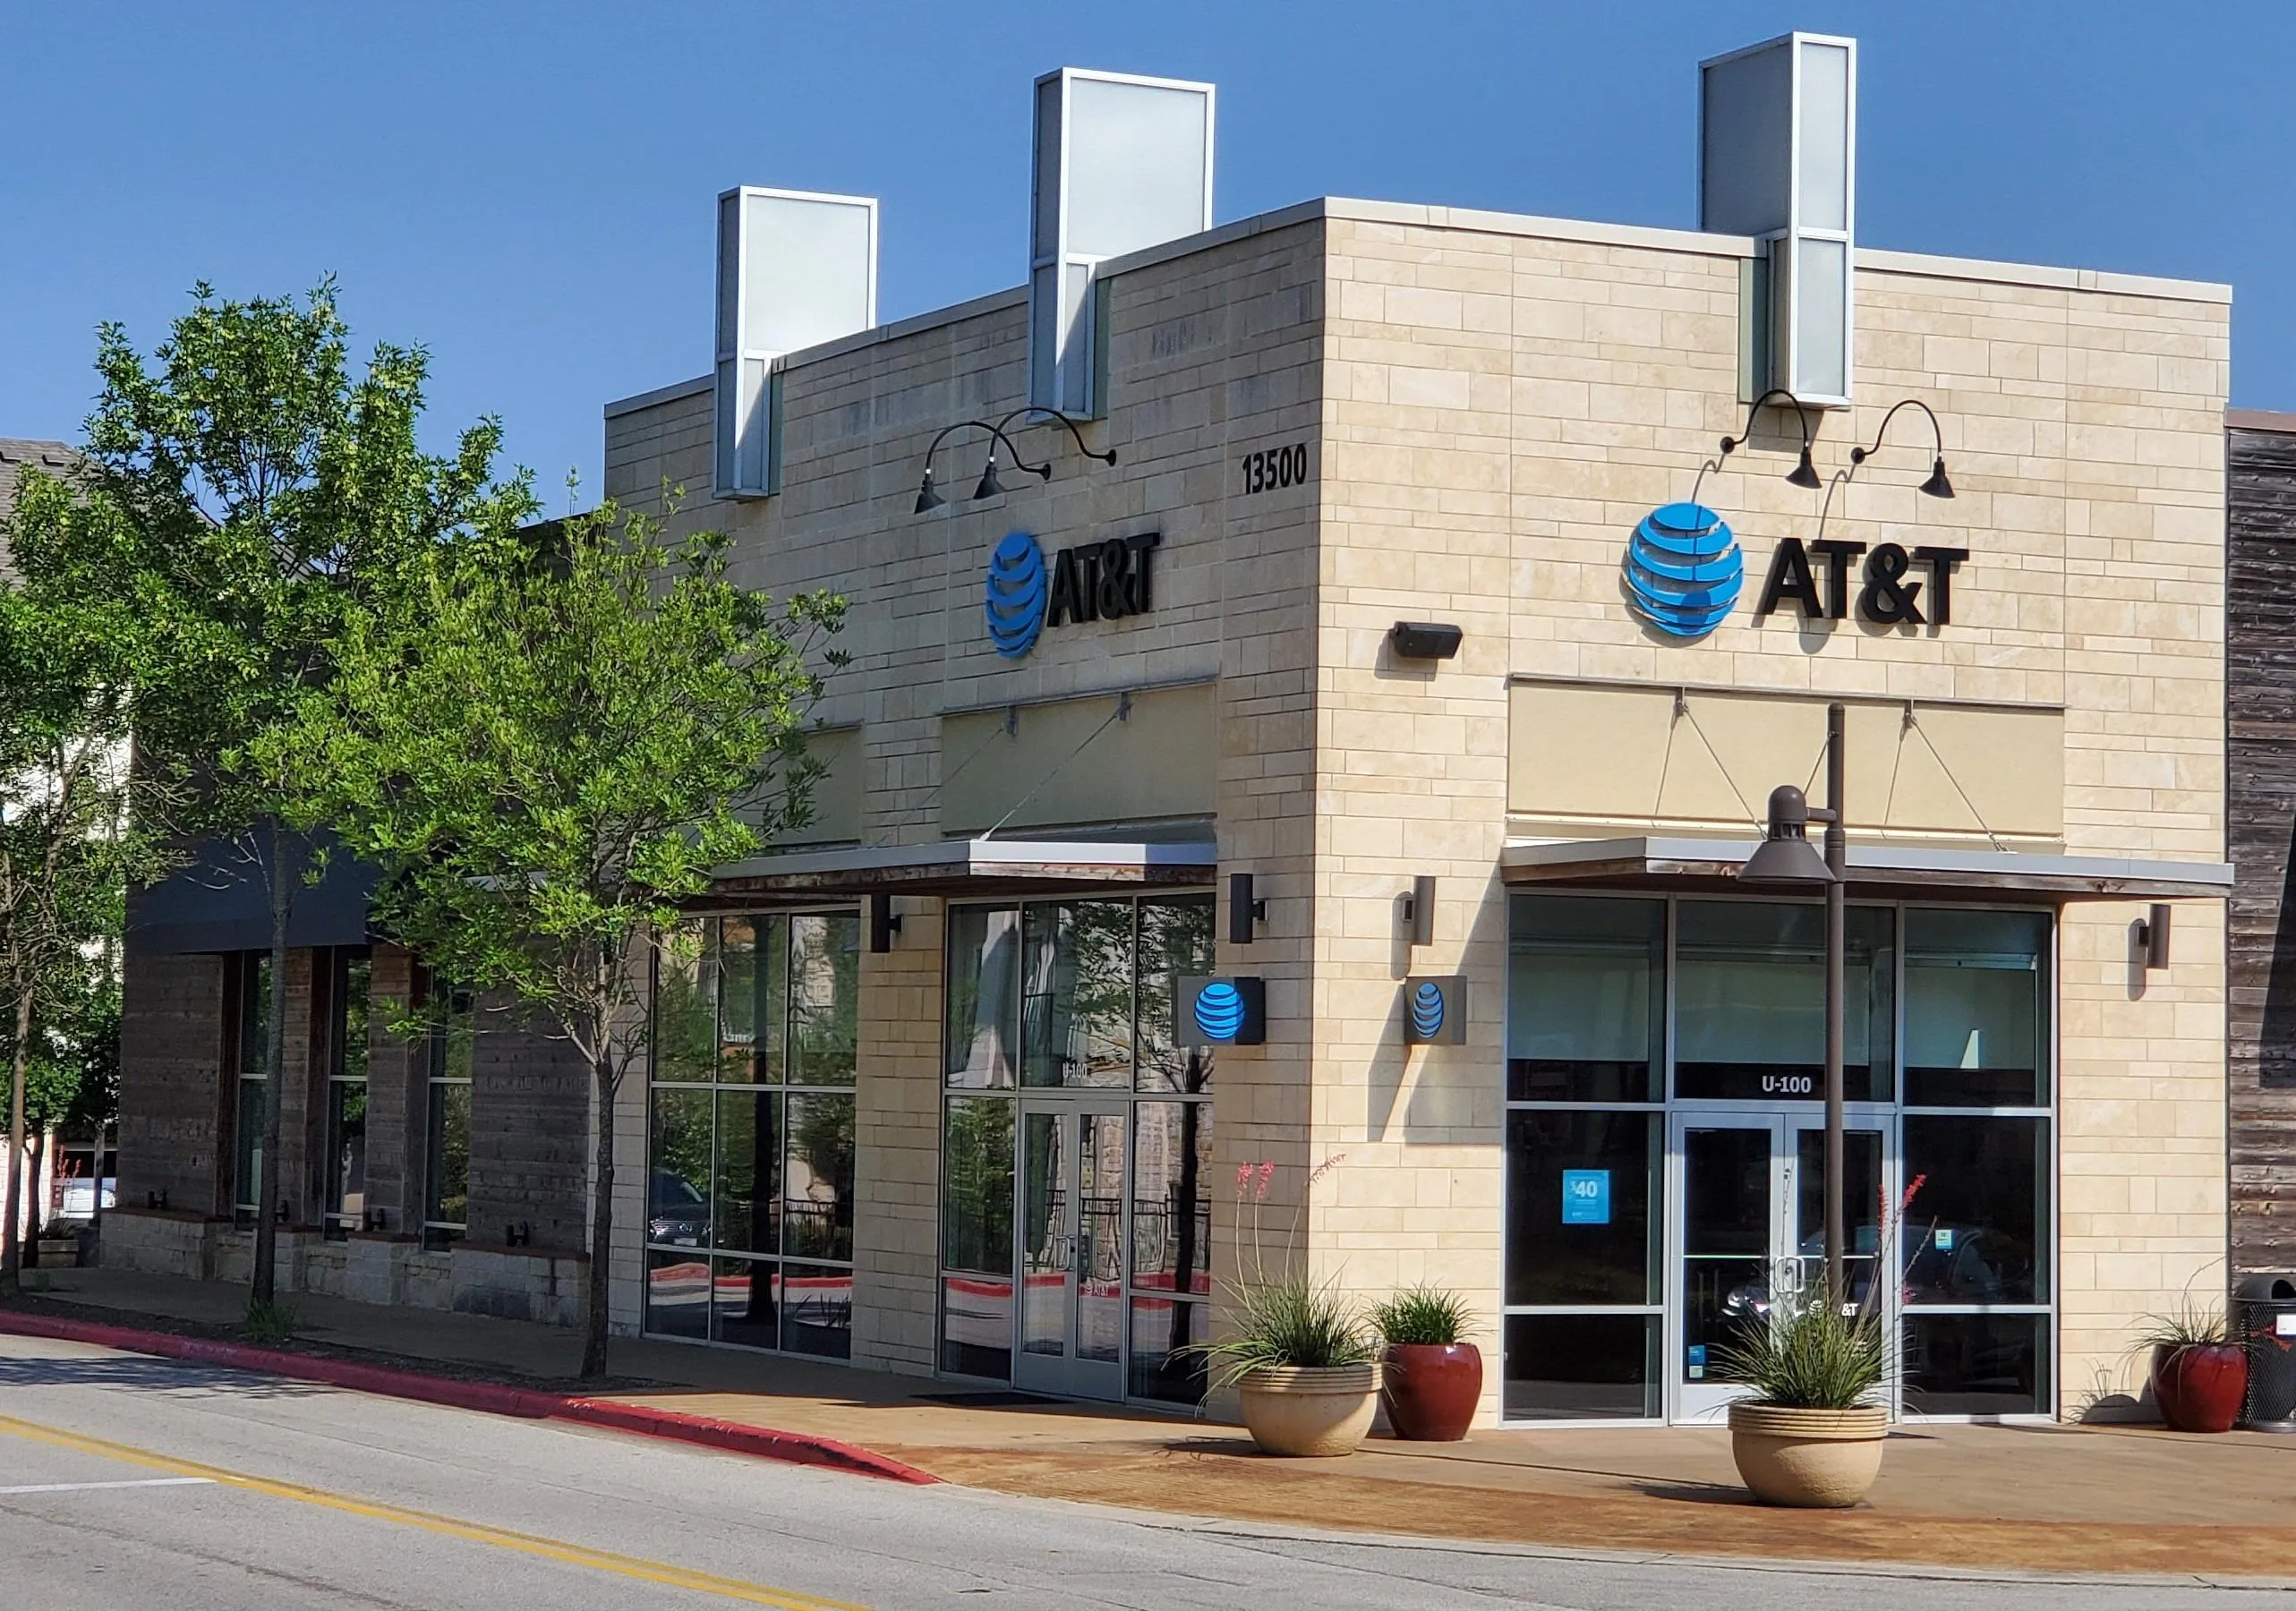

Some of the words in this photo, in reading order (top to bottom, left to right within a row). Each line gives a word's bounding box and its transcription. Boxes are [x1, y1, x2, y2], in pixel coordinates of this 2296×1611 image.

[1242, 443, 1307, 495] 13500
[1047, 533, 1161, 627] AT&T
[1761, 537, 1970, 626] AT&T
[1063, 1061, 1088, 1078] U-100
[1762, 1076, 1812, 1093] U-100
[1093, 1283, 1109, 1297] AT&T
[1841, 1302, 1860, 1317] &T
